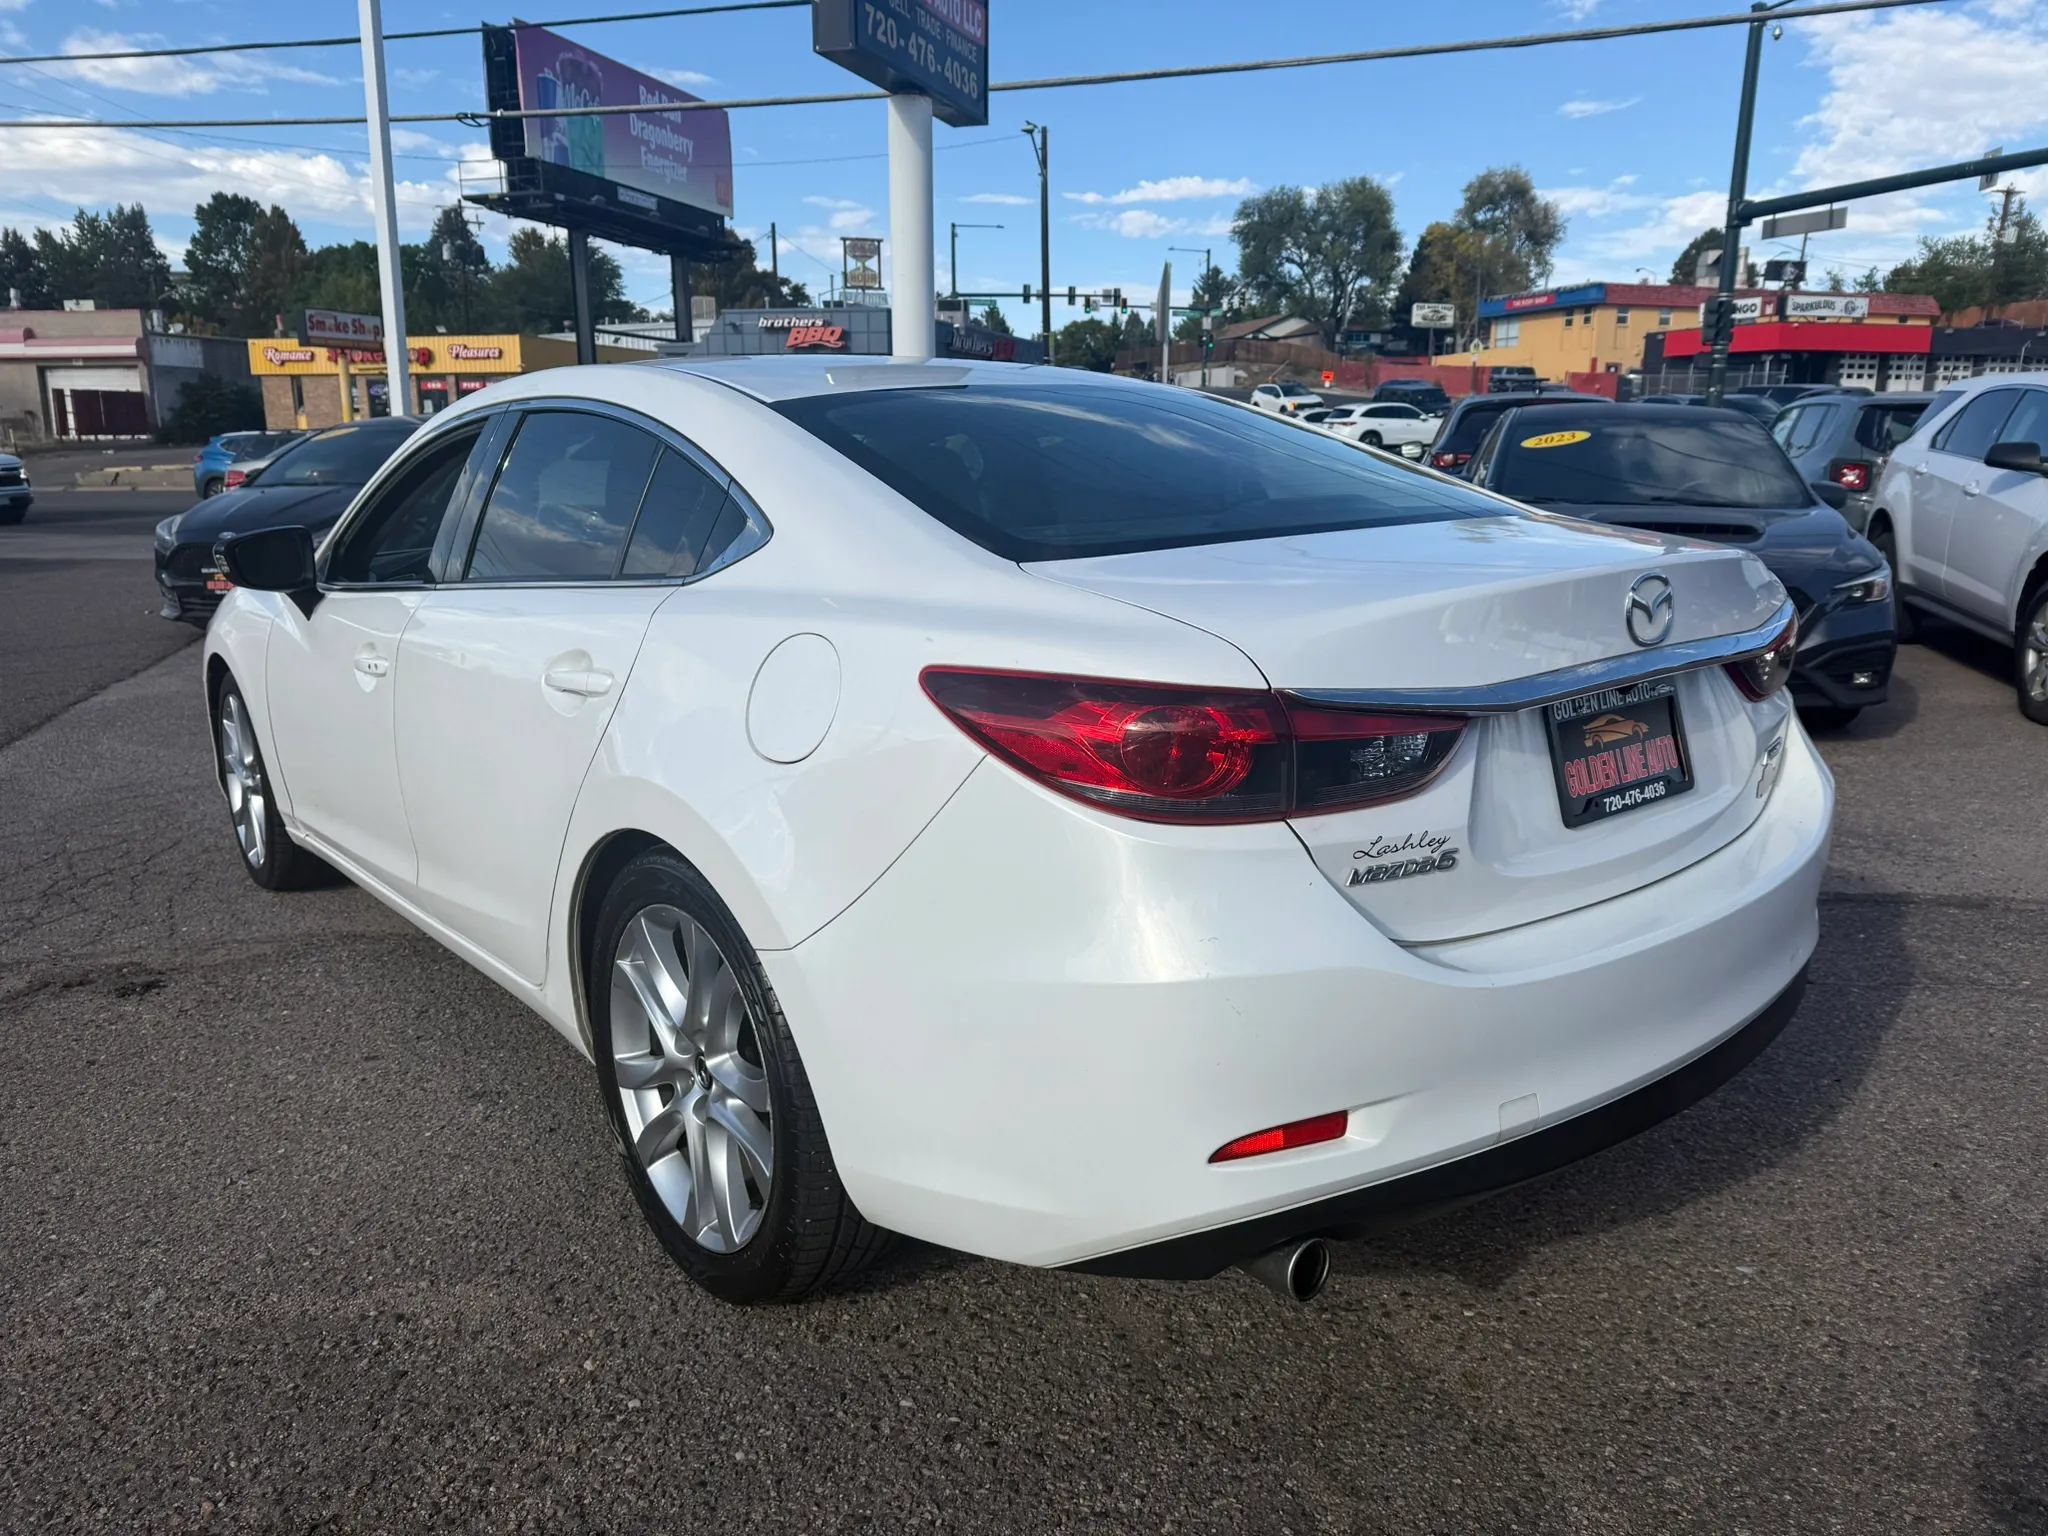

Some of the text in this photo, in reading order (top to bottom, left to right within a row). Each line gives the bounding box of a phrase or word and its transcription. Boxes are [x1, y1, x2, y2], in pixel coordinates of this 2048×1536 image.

[963, 0, 982, 38] LLC
[916, 6, 941, 40] TRADE
[946, 28, 977, 64] FINANCE
[639, 85, 660, 116] Red
[630, 112, 694, 163] Dragonberry
[641, 145, 688, 184] Energizer
[758, 317, 824, 327] brothers
[786, 327, 844, 348] BBQ
[264, 346, 312, 365] Romance
[449, 344, 500, 359] Pleasures
[1534, 432, 1577, 446] 2023
[1553, 682, 1650, 720] GOLDEN LINE AUTO
[1565, 734, 1679, 798] GOLDEN LINE AUTO
[1603, 781, 1666, 812] 720-476-4036
[1353, 830, 1450, 859] Lashley
